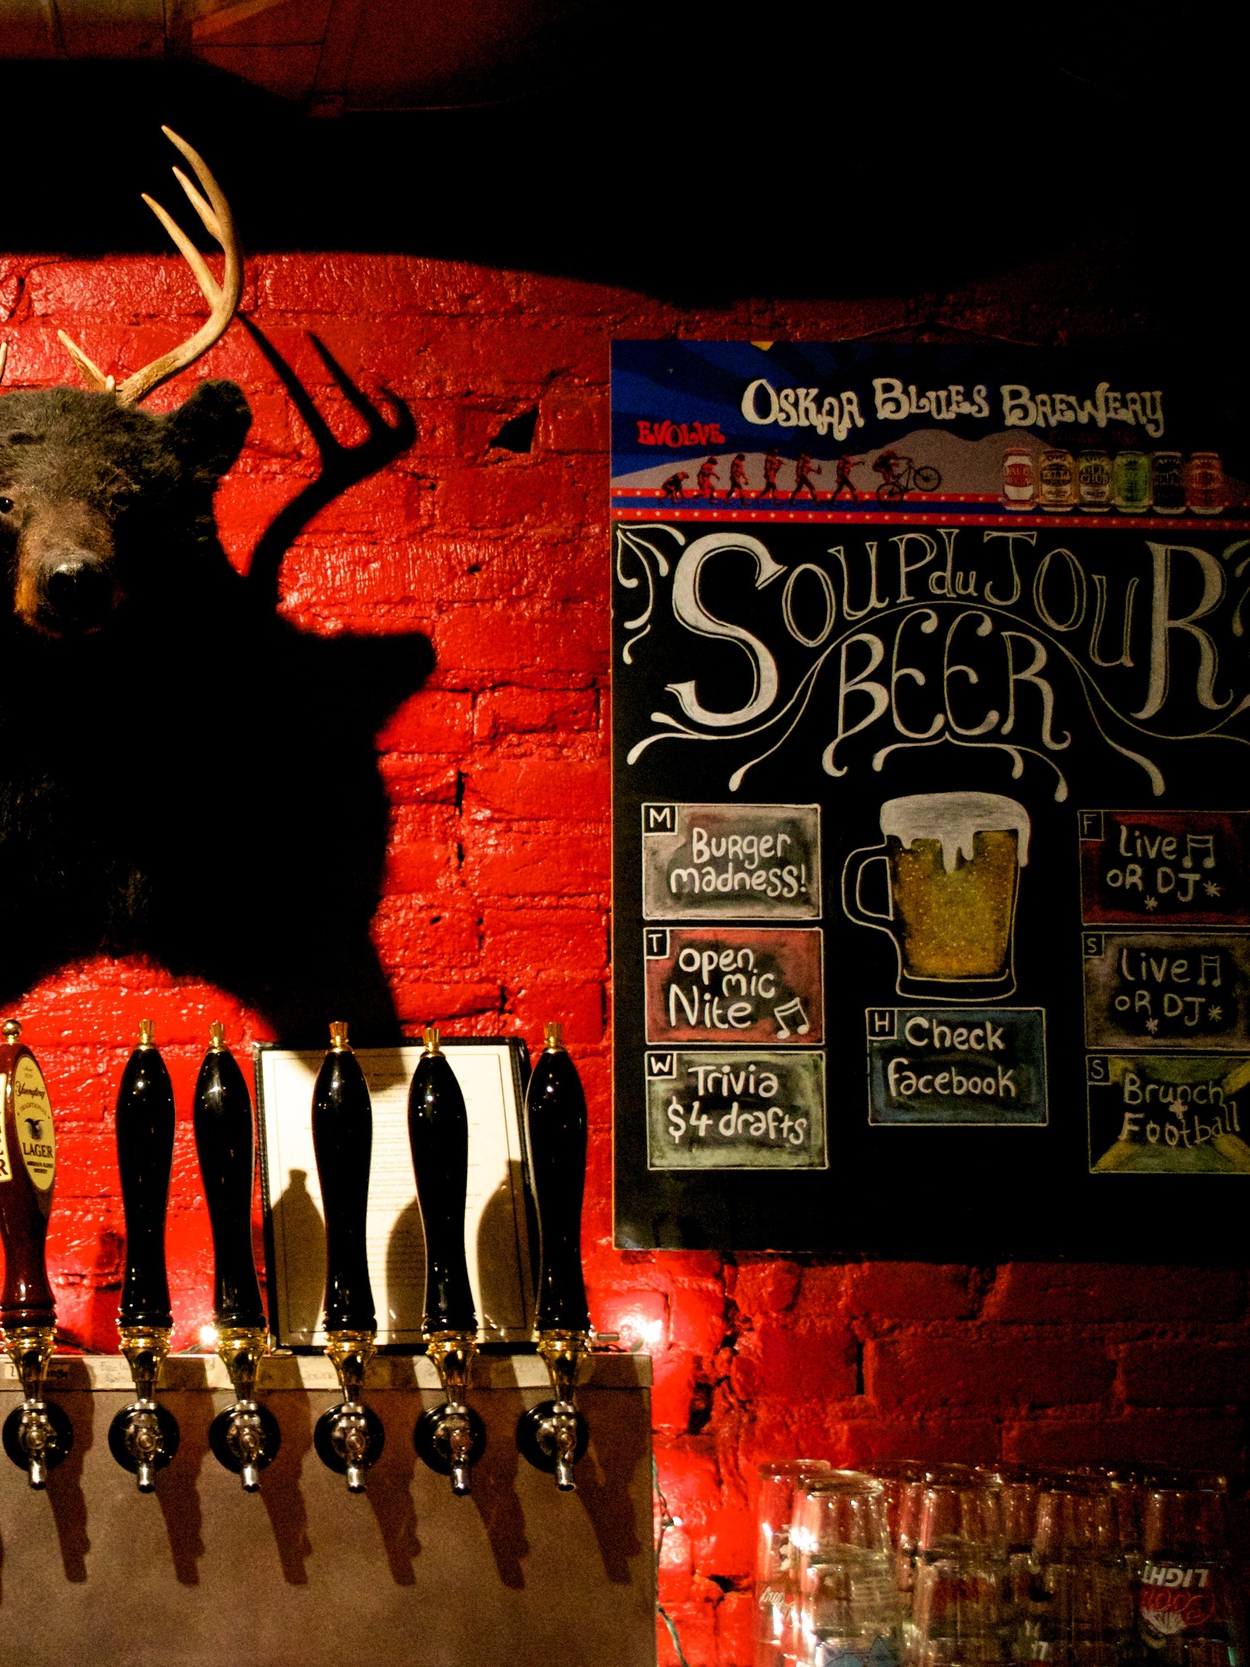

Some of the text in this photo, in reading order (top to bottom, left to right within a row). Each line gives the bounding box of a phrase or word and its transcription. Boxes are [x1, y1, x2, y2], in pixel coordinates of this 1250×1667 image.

[741, 377, 1164, 441] OSKAR BLUES BREWERY
[636, 420, 726, 448] EVOLVE
[664, 529, 1236, 727] SOUP du JOUR
[822, 608, 1072, 778] BEER
[649, 807, 671, 829] M
[1083, 814, 1098, 827] F
[670, 861, 807, 898] madness!
[1156, 865, 1201, 902] DJ
[648, 933, 663, 953] T
[1087, 937, 1098, 954] S
[722, 969, 775, 999] mic
[668, 983, 752, 1029] Nite
[875, 1012, 889, 1032] H
[1163, 993, 1206, 1026] DJ
[905, 1016, 1005, 1051] Check
[651, 1055, 672, 1074] W
[687, 1064, 779, 1098] Trivia
[1090, 1060, 1104, 1079] S
[1123, 1072, 1224, 1105] Brunch
[667, 1096, 808, 1145] $4 drafts
[1118, 1101, 1241, 1148] Football
[22, 1142, 54, 1159] LAGER
[1140, 1564, 1211, 1589] LIGHT
